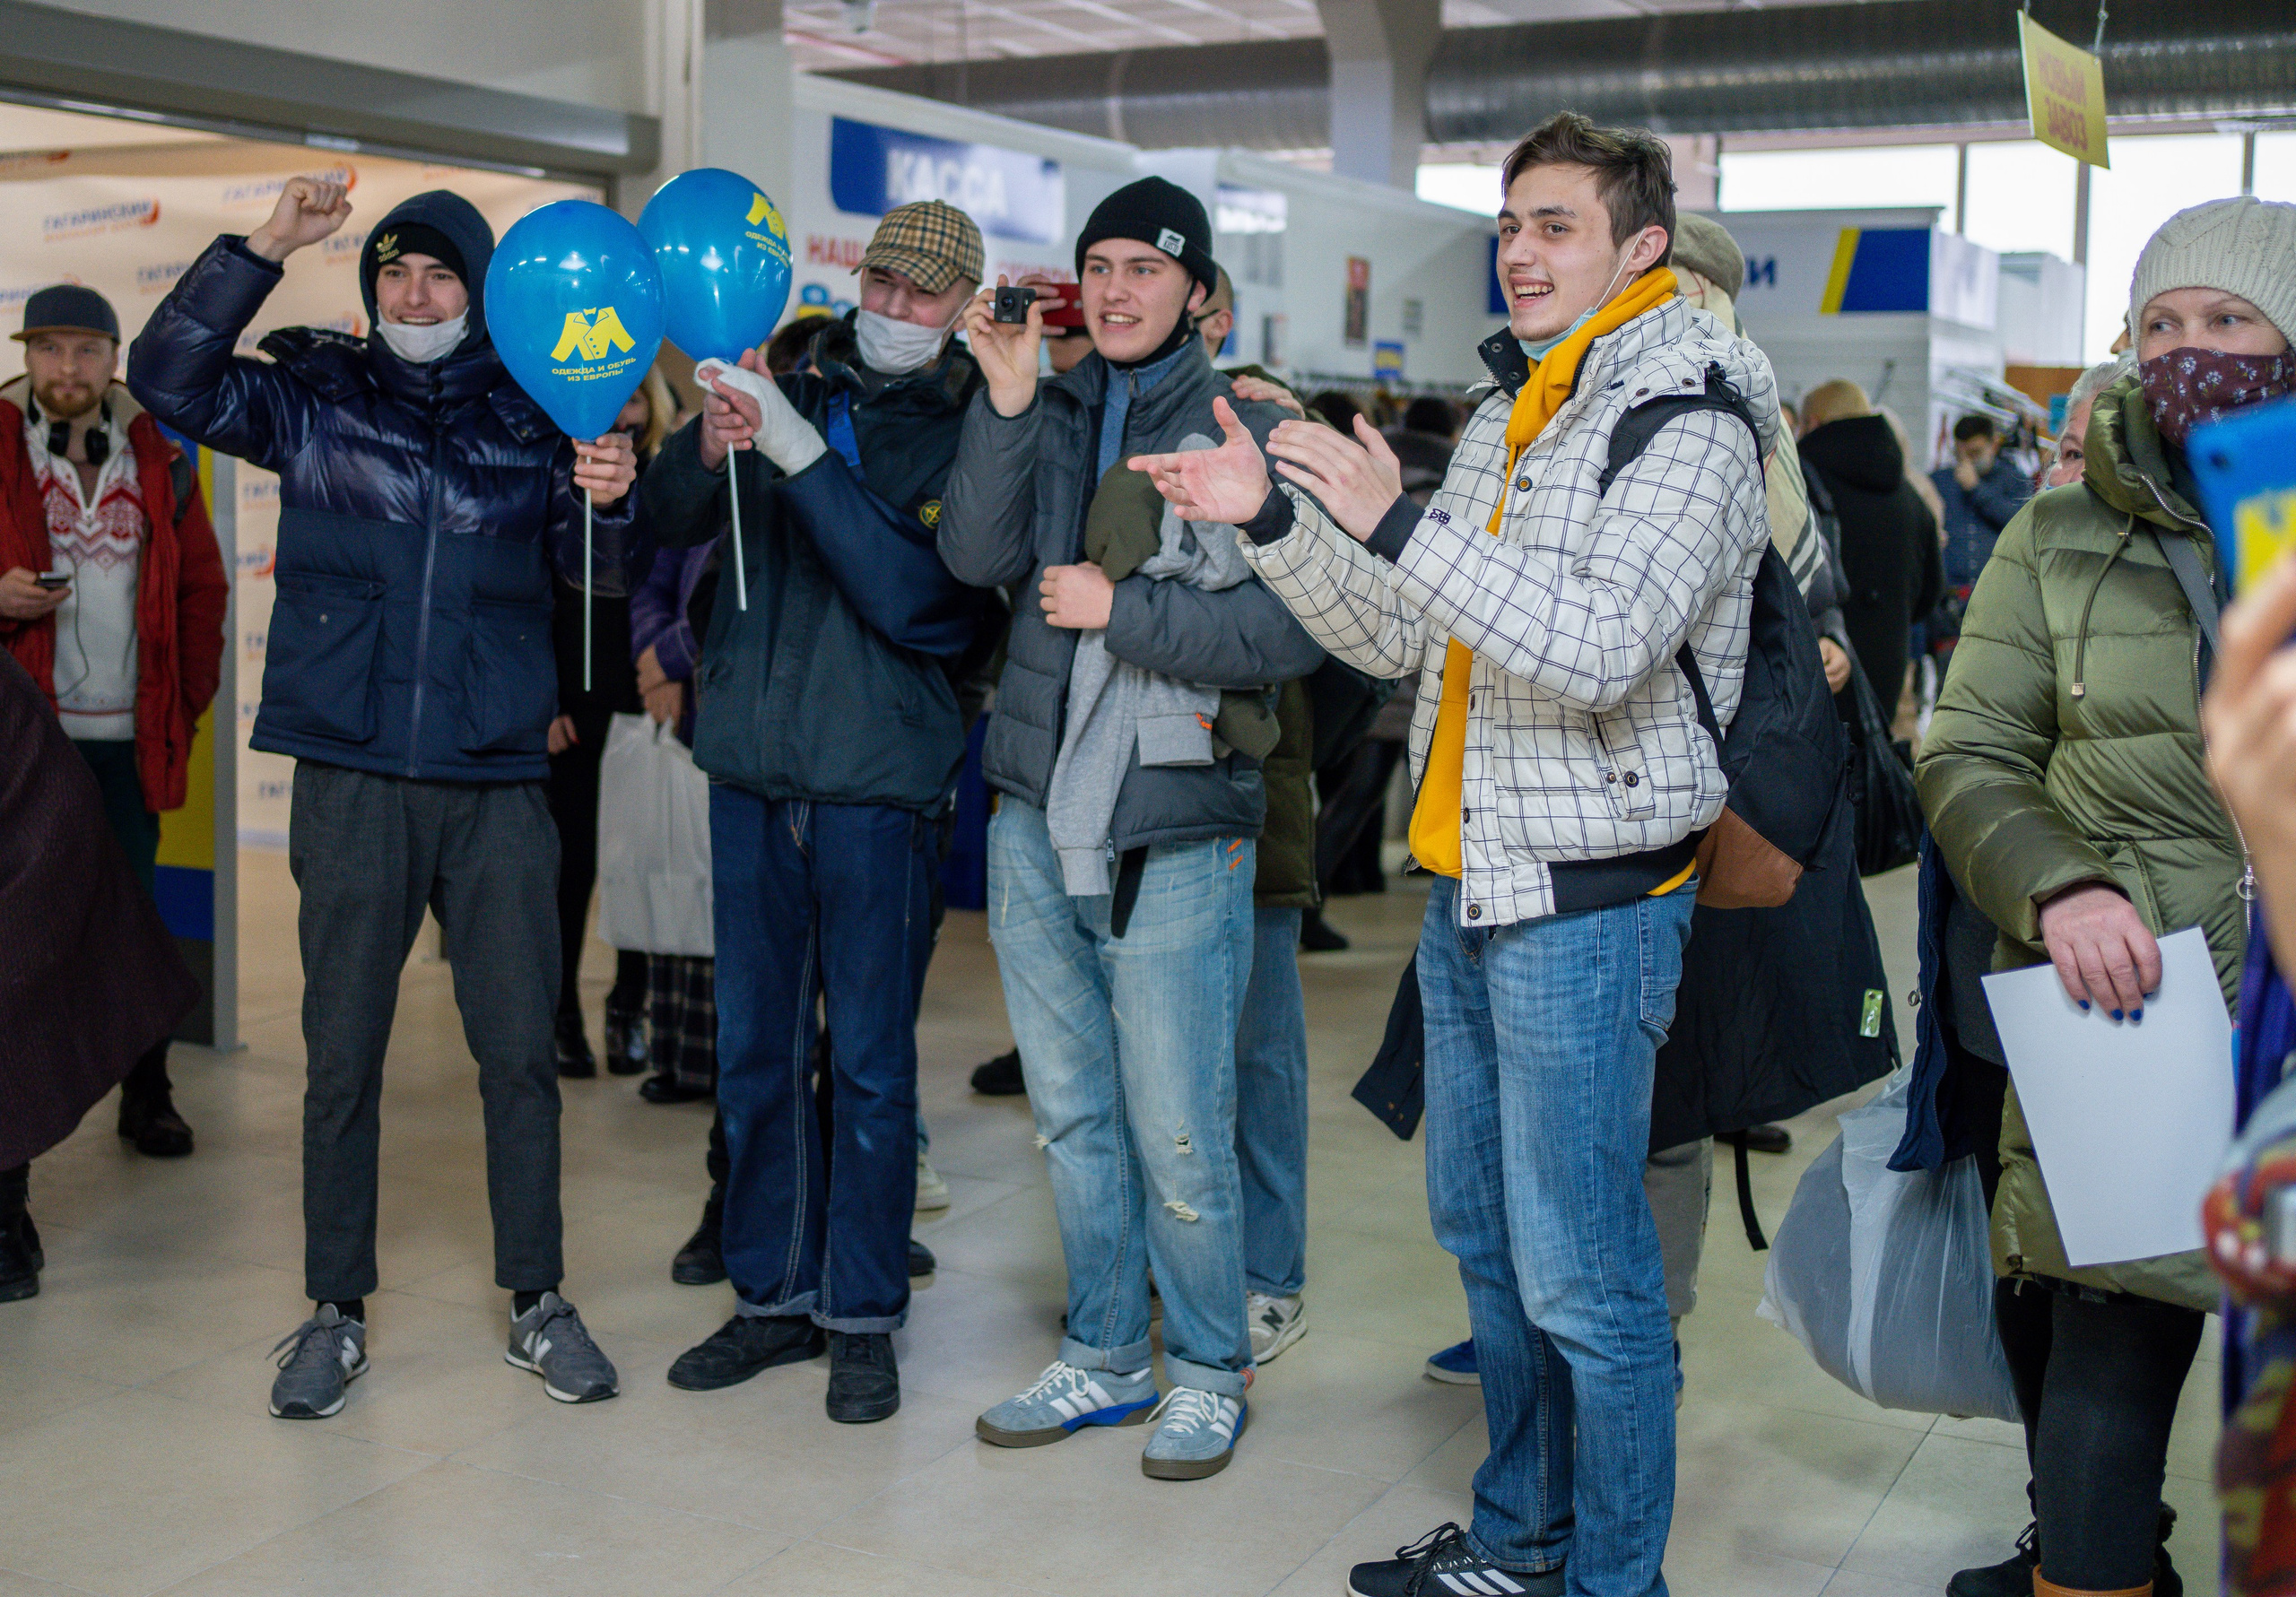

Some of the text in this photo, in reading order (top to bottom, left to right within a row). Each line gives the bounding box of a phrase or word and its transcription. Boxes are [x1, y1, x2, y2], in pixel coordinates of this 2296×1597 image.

[2044, 96, 2089, 152] ЗАВОЗ
[885, 148, 1010, 217] КАССА
[552, 366, 596, 376] ОДЕЖДА
[607, 357, 637, 370] ОБУВЬ
[583, 368, 623, 381] ЕВРОПЫ
